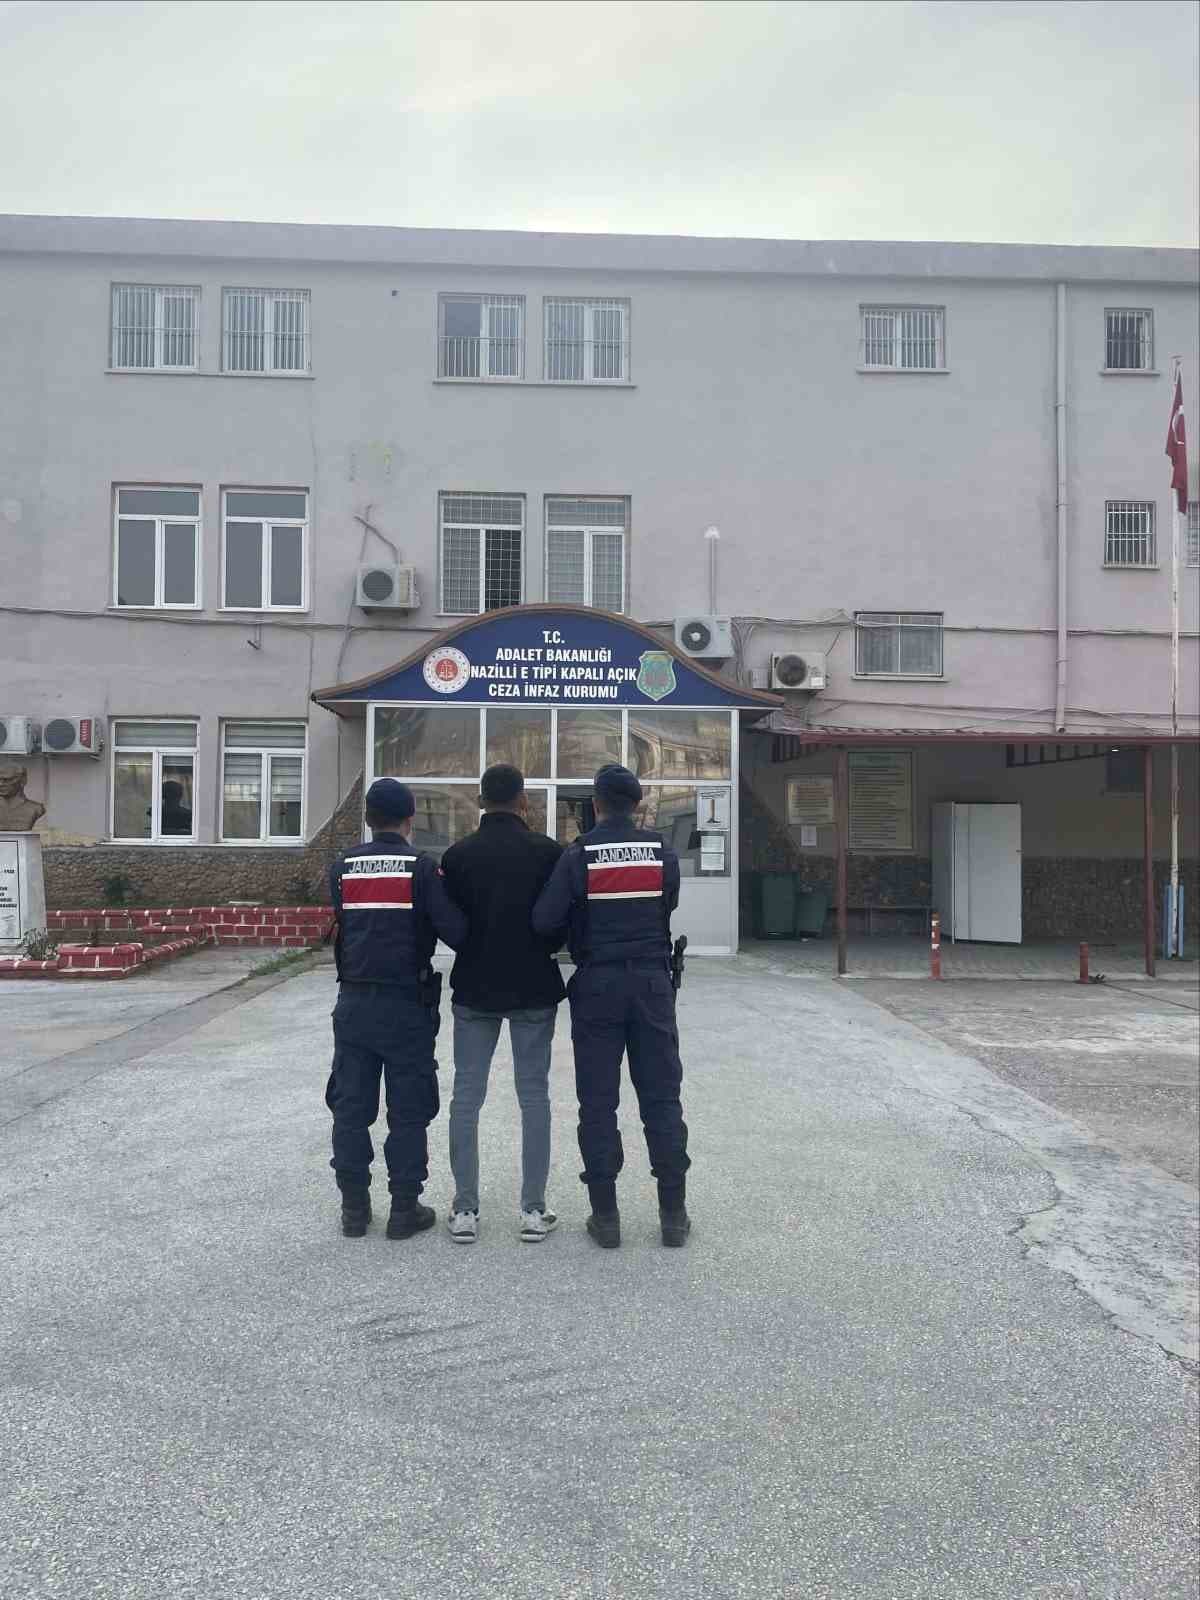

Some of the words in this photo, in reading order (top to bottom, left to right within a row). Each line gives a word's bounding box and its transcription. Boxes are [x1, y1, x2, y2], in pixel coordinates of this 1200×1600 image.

[543, 631, 565, 643] T.C.
[496, 648, 542, 661] ADALET
[547, 647, 612, 662] BAKANLIĞI
[471, 664, 517, 679] NAZİLLİ
[521, 667, 529, 679] E
[533, 664, 557, 680] TİPİ
[561, 668, 603, 681] KAPALI
[608, 668, 637, 683] AÇIK
[489, 684, 520, 697] CEZA
[524, 682, 559, 697] İNFAZ
[564, 685, 618, 698] KURUMU
[595, 847, 656, 863] JANDARMA
[348, 859, 406, 874] JANDARMA
